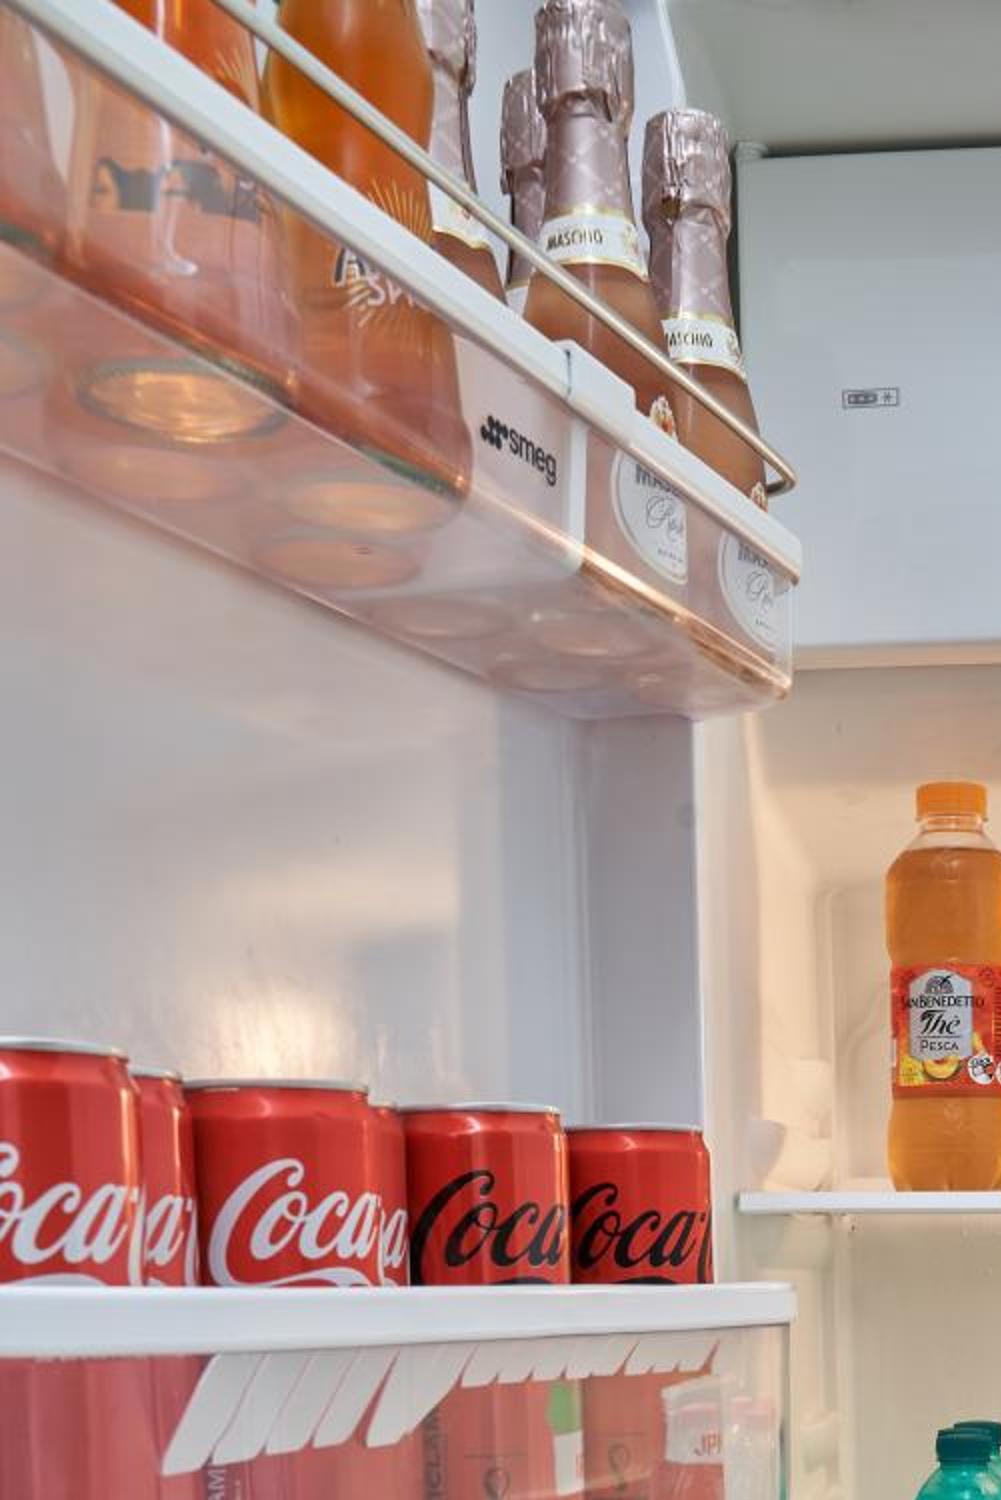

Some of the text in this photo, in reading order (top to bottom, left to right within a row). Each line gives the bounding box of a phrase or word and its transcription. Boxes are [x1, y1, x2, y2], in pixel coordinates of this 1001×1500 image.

[546, 229, 603, 250] MASCHIO
[508, 427, 558, 487] smeg
[920, 1040, 959, 1052] PESCA
[208, 1158, 381, 1286] Coca
[409, 1169, 566, 1286] Coca
